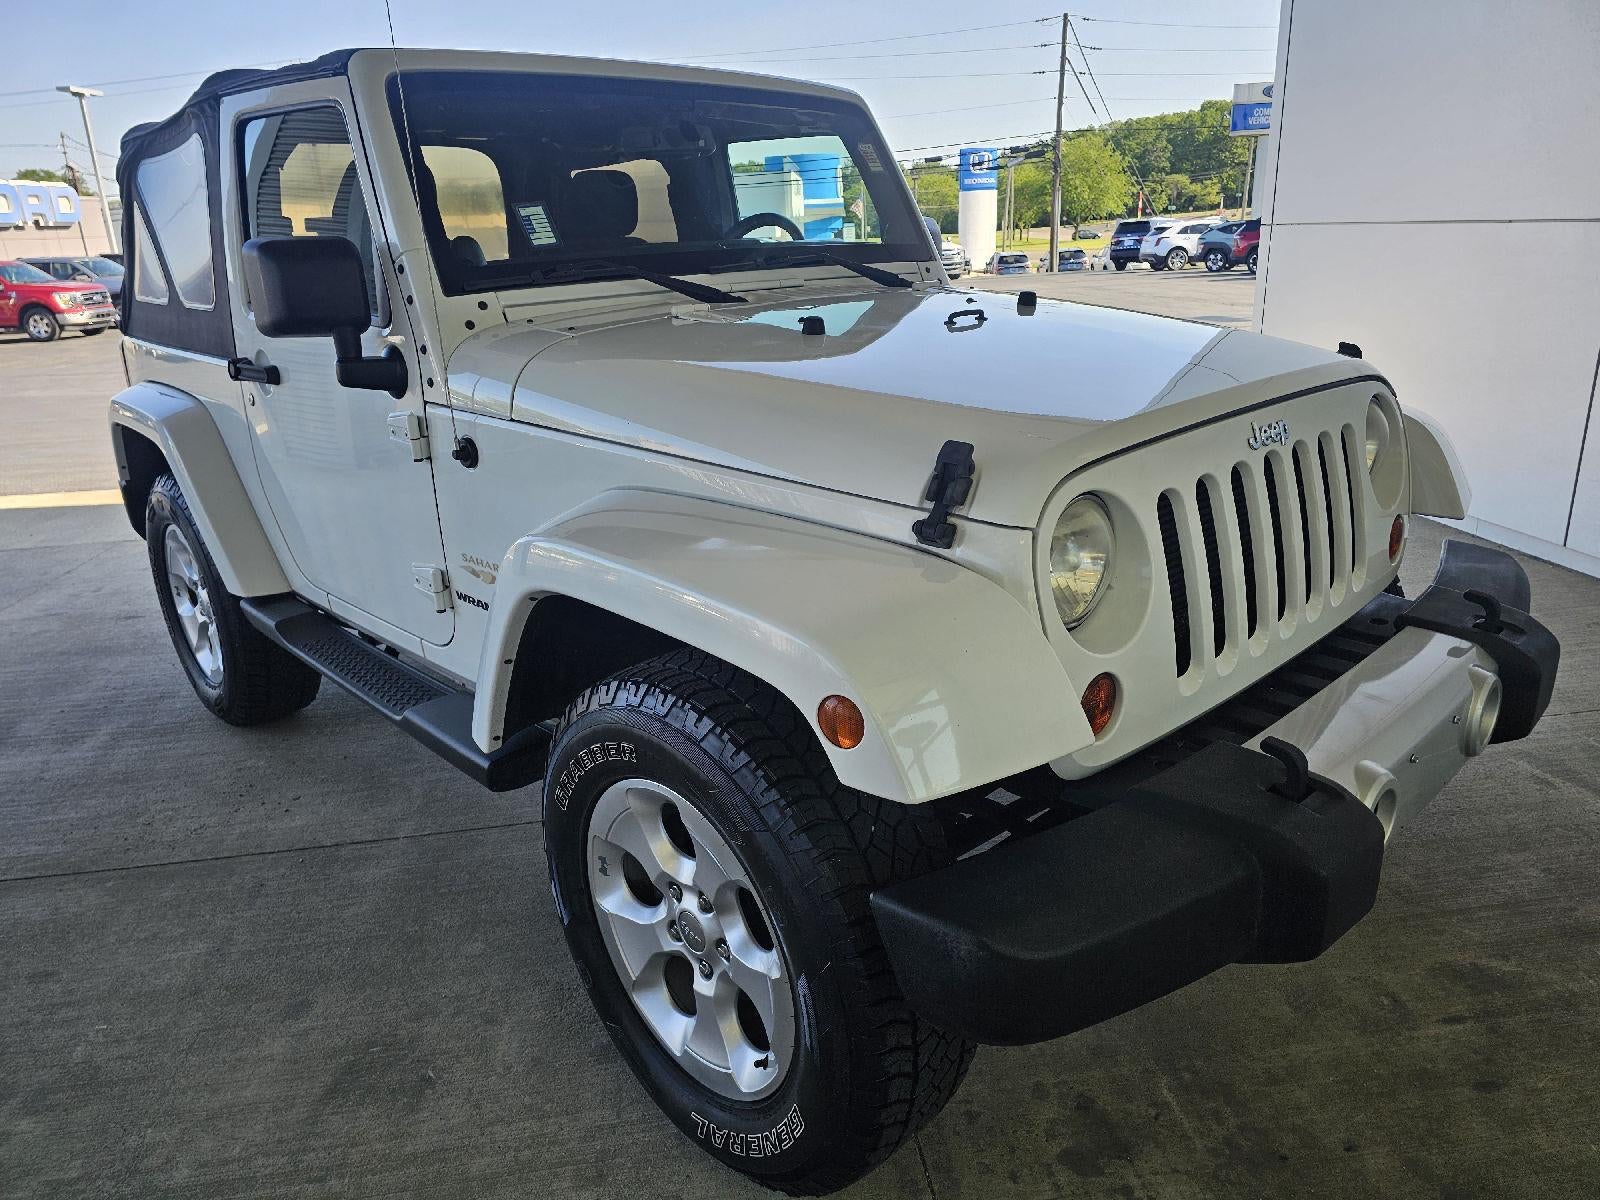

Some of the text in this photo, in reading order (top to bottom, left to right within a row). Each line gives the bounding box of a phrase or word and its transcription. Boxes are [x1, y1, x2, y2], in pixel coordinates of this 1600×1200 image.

[1248, 420, 1290, 451] Jeep
[555, 741, 637, 811] GRABBER
[690, 1103, 805, 1157] GENERAL
